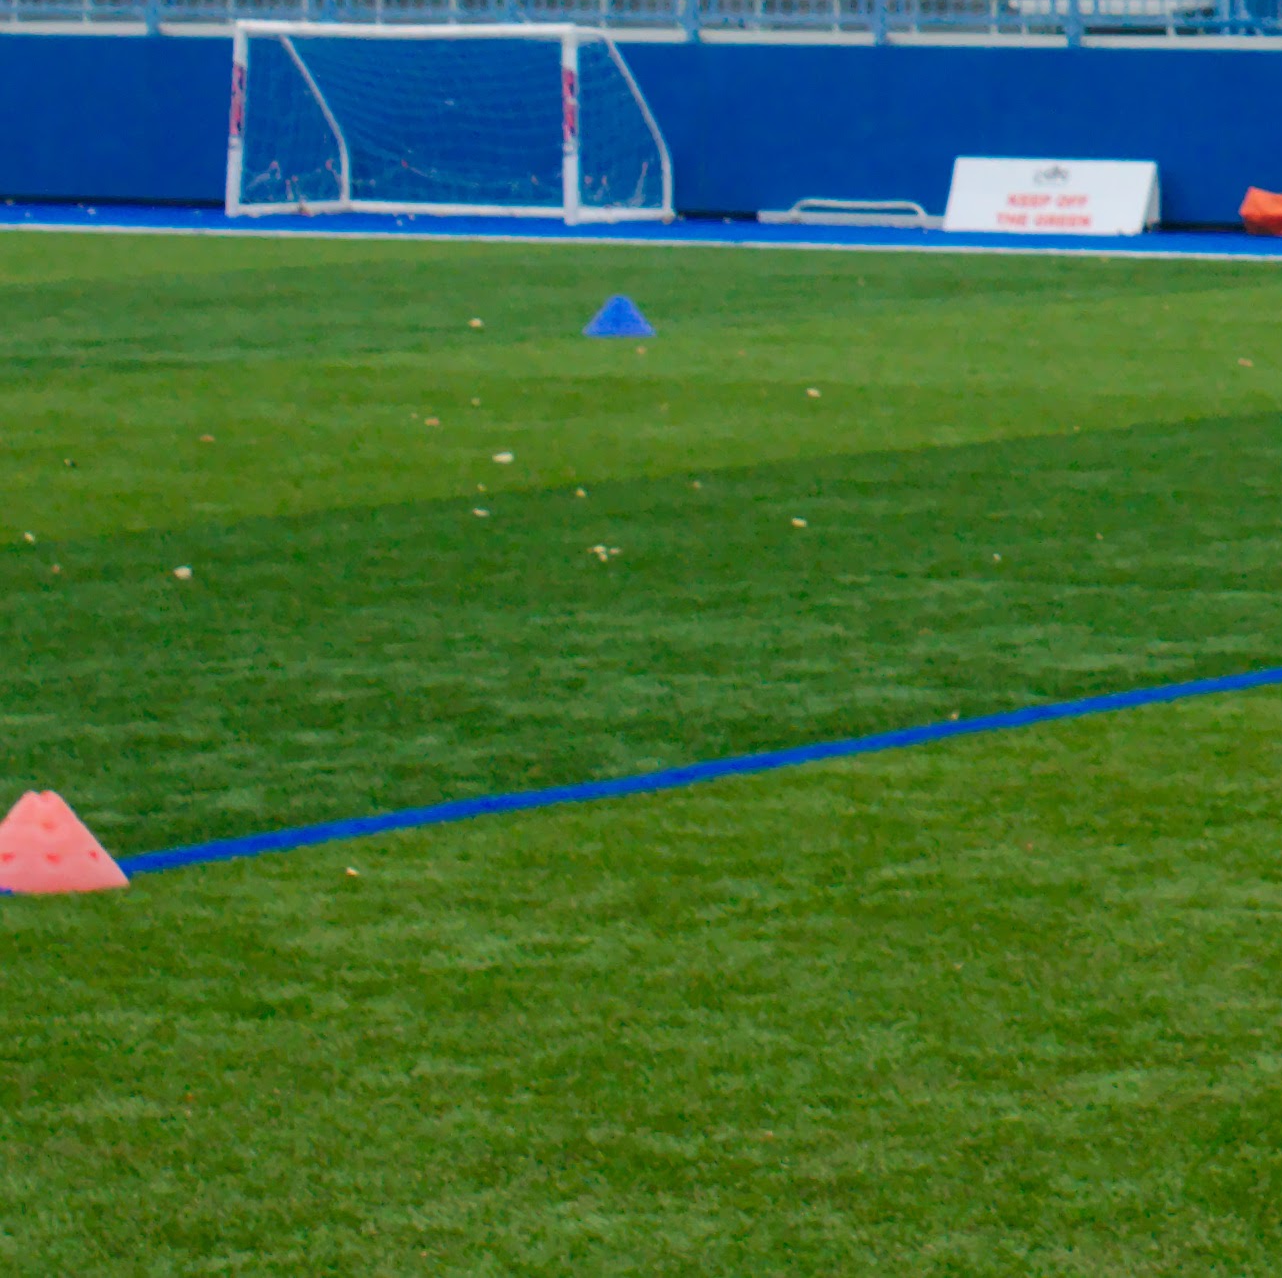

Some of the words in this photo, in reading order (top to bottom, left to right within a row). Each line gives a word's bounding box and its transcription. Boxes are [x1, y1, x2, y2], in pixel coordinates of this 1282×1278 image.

[1007, 193, 1050, 207] KEEP
[1056, 194, 1089, 207] OFF
[996, 212, 1026, 226] THE
[1035, 213, 1092, 227] GREEN
